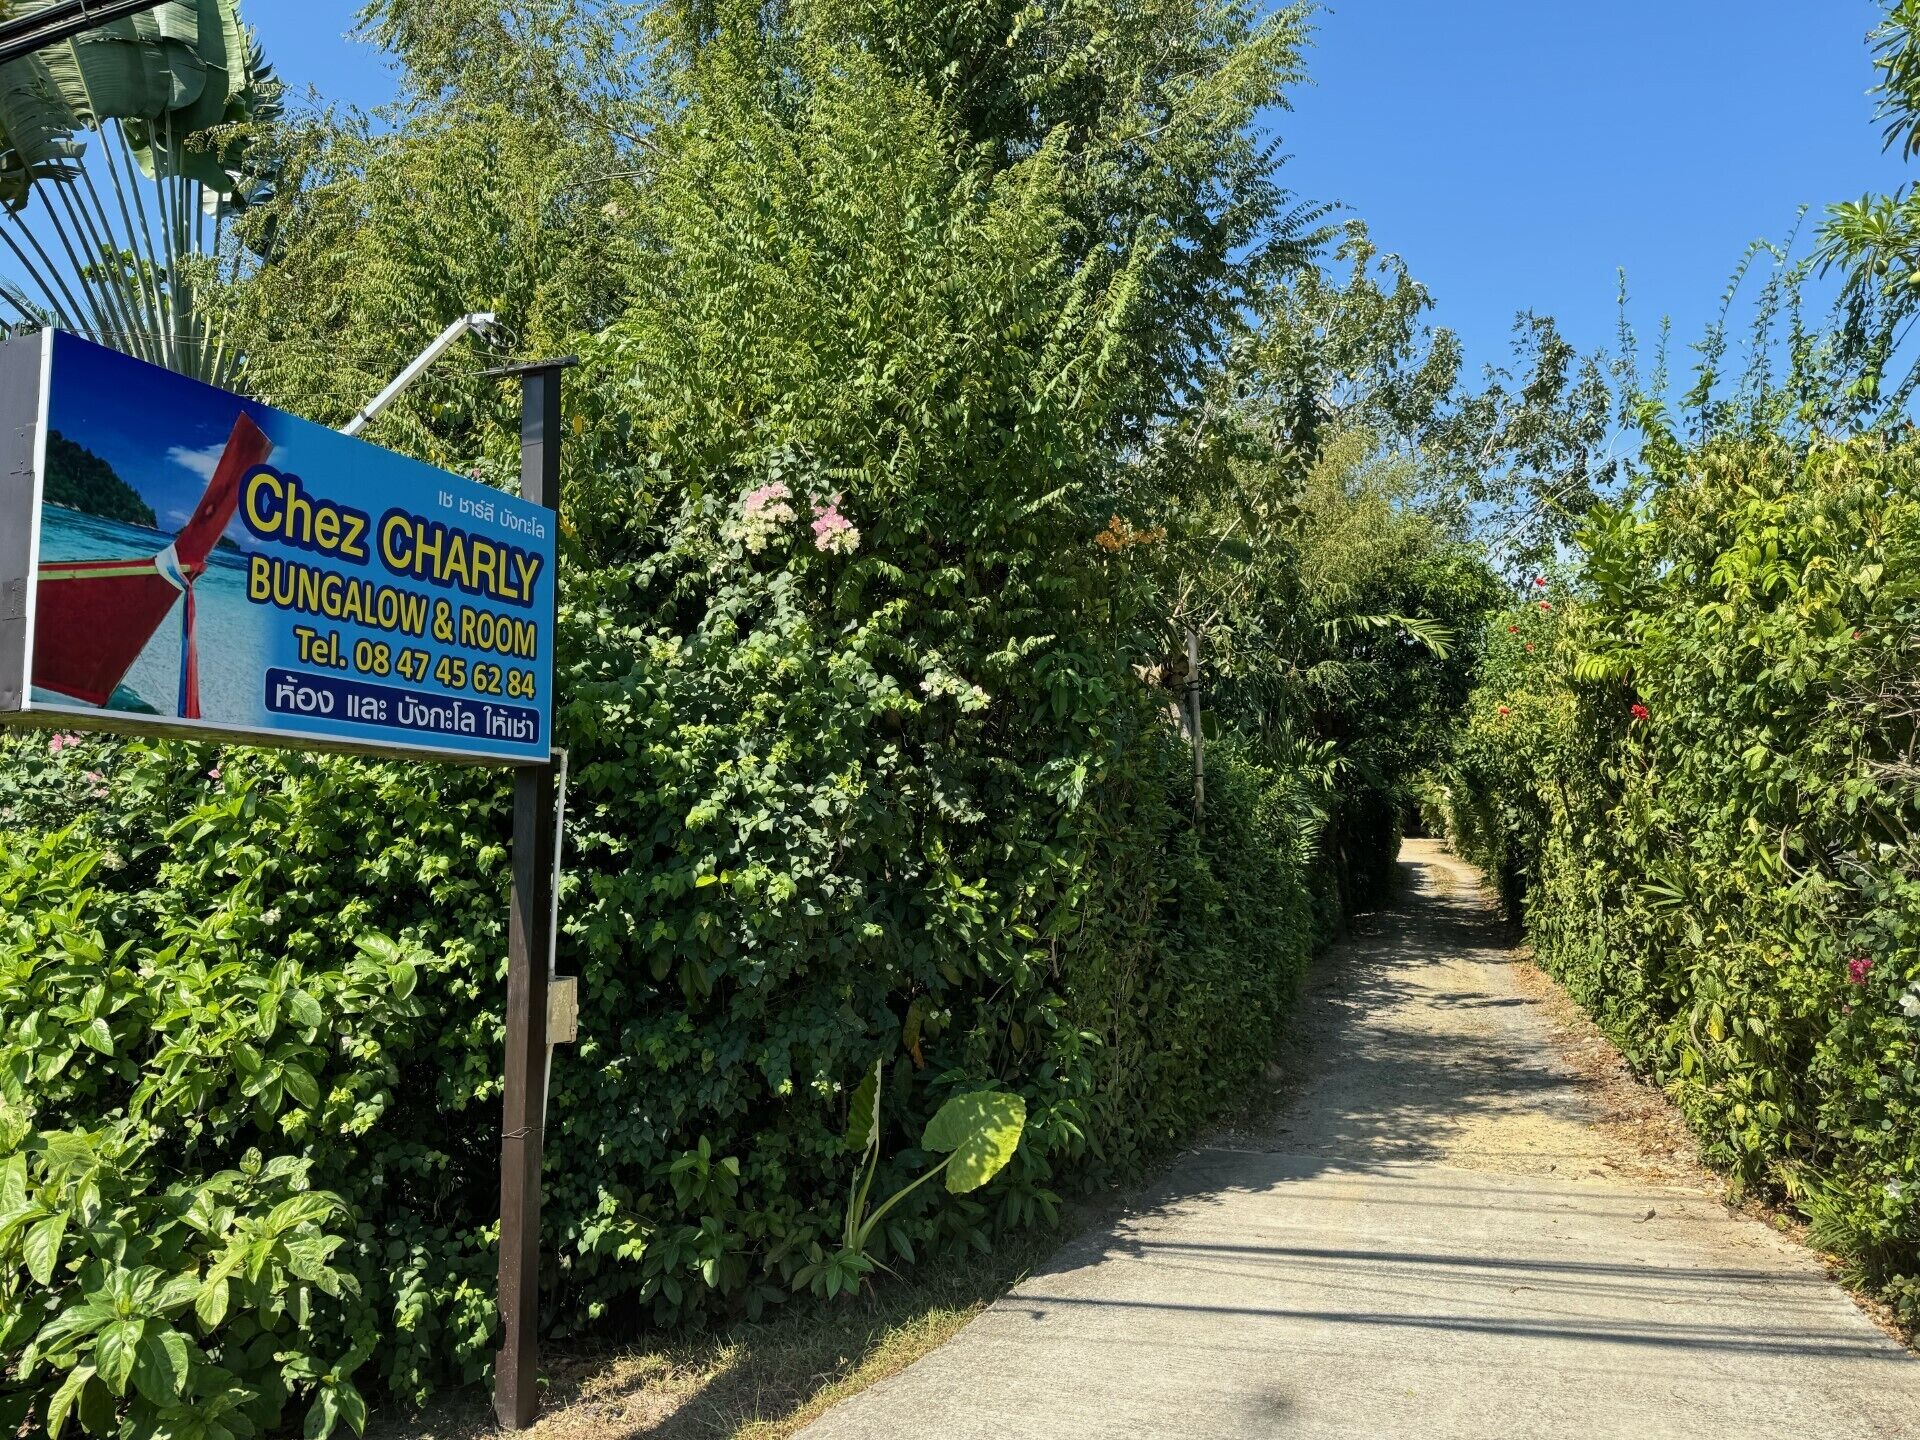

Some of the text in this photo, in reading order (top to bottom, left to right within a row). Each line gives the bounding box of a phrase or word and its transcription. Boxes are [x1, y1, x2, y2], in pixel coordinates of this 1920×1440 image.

[246, 473, 540, 602] Chez CHARLY
[250, 556, 536, 658] BUNGALOW & ROOM
[295, 627, 535, 698] Tel. 08 47 45 62 84
[275, 675, 534, 740] ห้อง และ บังกะโล ให้เช่า
